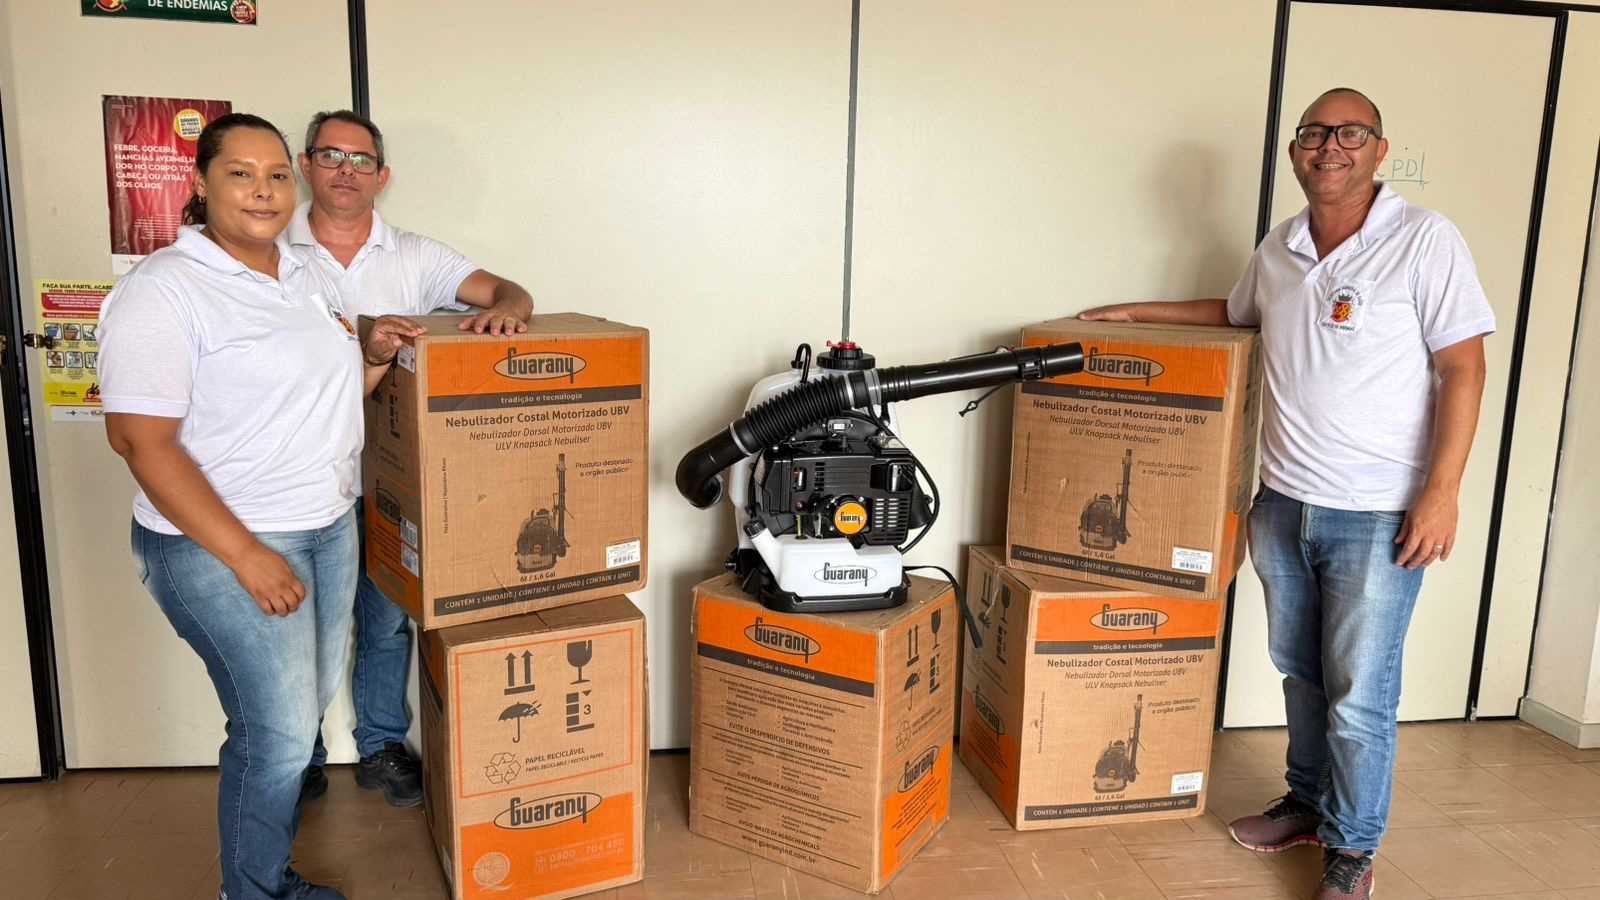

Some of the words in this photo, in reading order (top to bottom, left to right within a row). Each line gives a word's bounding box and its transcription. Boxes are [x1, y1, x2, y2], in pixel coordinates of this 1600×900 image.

[148, 0, 163, 8] DE
[168, 0, 228, 11] ENDEMIAS
[114, 144, 140, 152] FEBRE,
[142, 145, 178, 154] COCEIRA,
[508, 347, 574, 384] Guarany
[1088, 346, 1152, 386] Guarany
[501, 392, 534, 404] tradição
[543, 392, 582, 402] tecnologia
[1079, 388, 1108, 400] tradição
[1117, 392, 1157, 402] tecnologia
[446, 414, 514, 428] Nebulizador
[517, 411, 550, 423] Costal
[552, 408, 608, 421] Motorizado
[610, 406, 630, 416] UBV
[1033, 400, 1090, 414] Nebulizador
[1091, 405, 1122, 416] Costal
[1124, 409, 1182, 422] Motorizado
[1185, 415, 1208, 425] UBV
[470, 428, 522, 441] Nebulizador
[524, 426, 550, 438] Dorsal
[552, 424, 595, 435] Motorizado
[596, 422, 612, 432] UBV
[1050, 416, 1094, 426] Nebulizador
[1095, 419, 1120, 430] Dorsal
[1122, 422, 1167, 434] Motorizado
[1168, 426, 1186, 436] UBV
[495, 442, 512, 451] ULV
[514, 438, 552, 450] Knapsack
[554, 436, 591, 447] Nebuliser
[1070, 428, 1084, 436] ULV
[1086, 429, 1121, 441] Knapsack
[1122, 434, 1161, 444] Nebuliser
[840, 512, 861, 525] Guarany
[1048, 555, 1074, 566] UNIDADE
[824, 562, 868, 586] Guarany
[482, 592, 512, 602] UNIDADE
[518, 585, 549, 596] CONTIENE
[556, 580, 581, 590] UNIDAD
[586, 576, 612, 585] CONTAIN
[1102, 604, 1158, 635] Guarany
[754, 616, 810, 664] Guarany
[1093, 642, 1121, 652] tradição
[1128, 642, 1163, 651] tecnologia
[746, 657, 774, 670] tradição
[780, 666, 816, 680] tecnologia
[1047, 658, 1103, 668] Nebulizador
[1105, 657, 1134, 667] Costal
[1135, 656, 1184, 666] Motorizado
[1185, 654, 1204, 664] UBV
[1064, 670, 1108, 680] Nebulizador
[1108, 670, 1132, 678] Dorsal
[1133, 668, 1171, 678] Motorizado
[1172, 668, 1186, 676] UBV
[1085, 681, 1099, 689] ULV
[1100, 680, 1133, 690] Knapsack
[583, 704, 592, 715] 3
[526, 756, 545, 764] PAPEL
[904, 749, 936, 790] Guarany
[510, 795, 588, 826] Guarany
